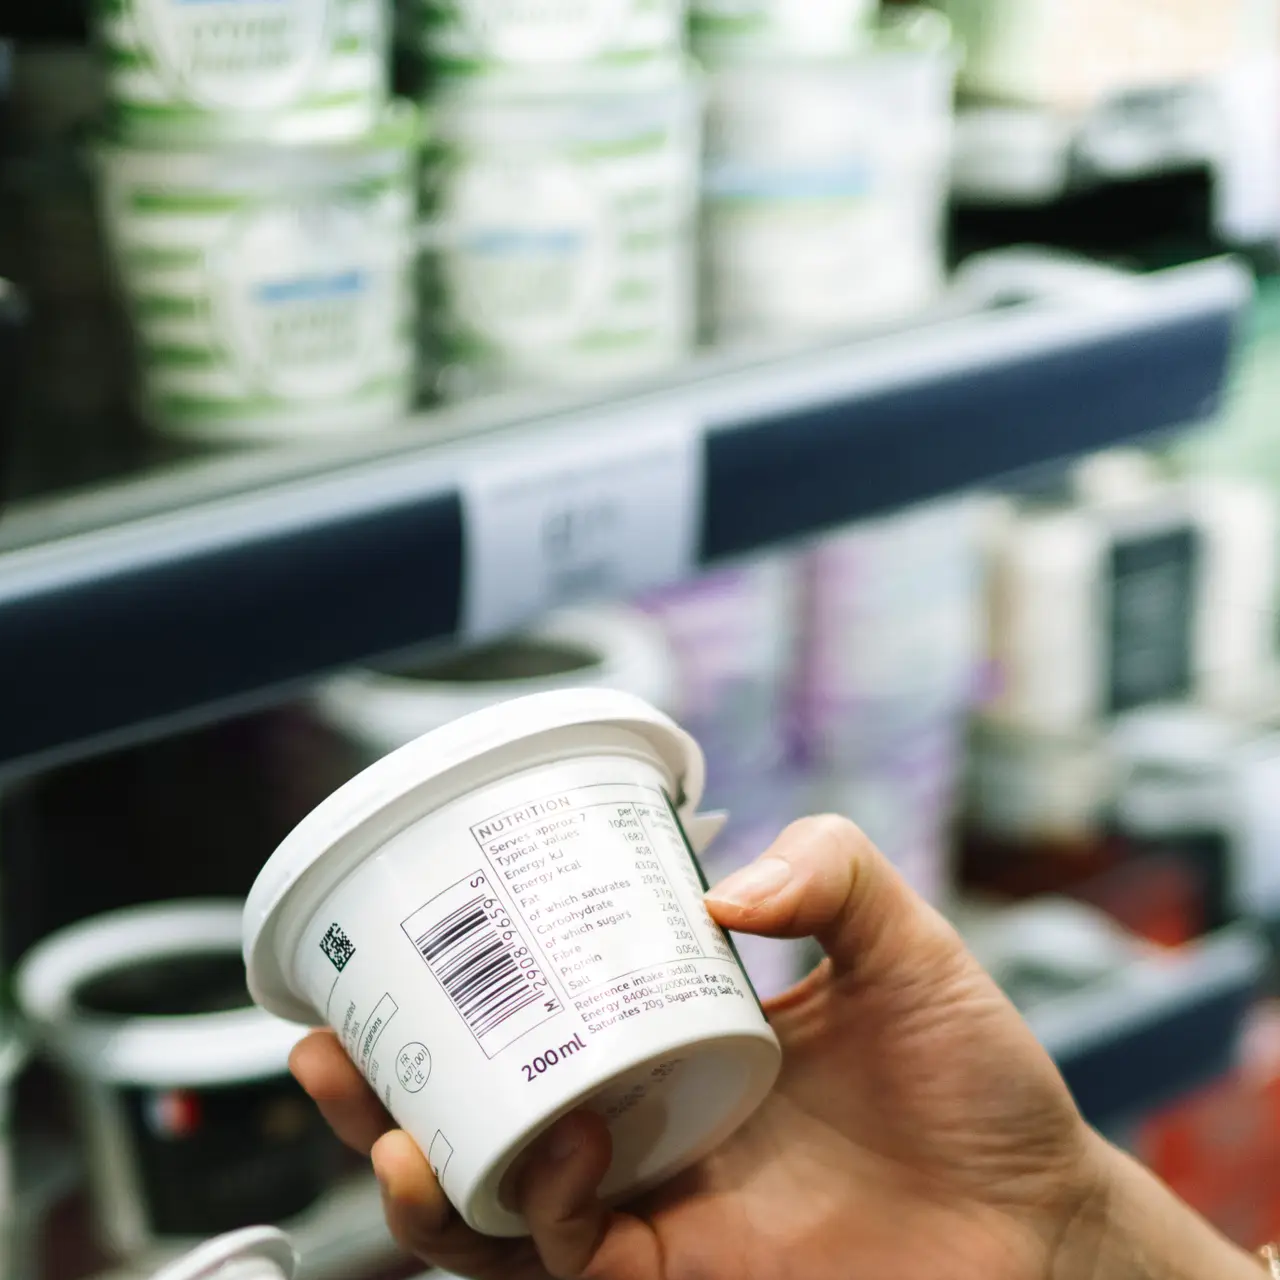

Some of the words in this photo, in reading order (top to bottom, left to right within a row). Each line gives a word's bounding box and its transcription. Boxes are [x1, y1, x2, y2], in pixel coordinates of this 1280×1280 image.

[478, 796, 571, 839] NUTRITION
[489, 832, 531, 855] Serves
[495, 842, 539, 867] Typical
[542, 829, 580, 847] values
[504, 857, 546, 880] Energy
[512, 871, 553, 894] Energy
[556, 859, 582, 875] kcal
[520, 893, 541, 908] Fat
[530, 909, 541, 921] of
[545, 894, 579, 913] which
[581, 879, 631, 900] saturates
[537, 898, 614, 935] Carbohydrate
[483, 898, 516, 941] 9659
[545, 936, 557, 949] of
[561, 922, 594, 941] which
[596, 910, 632, 928] sugars
[513, 946, 547, 991] 2908
[552, 944, 582, 963] Fibre
[560, 953, 602, 977] Protein
[568, 974, 591, 990] Salt
[574, 983, 630, 1011] Reference
[632, 970, 664, 986] intake
[580, 1001, 620, 1023] Energy
[588, 1005, 640, 1034] Saturates
[642, 998, 664, 1012] 20g
[665, 990, 698, 1005] Sugars
[699, 986, 717, 997] 90g
[415, 1070, 425, 1084] CE
